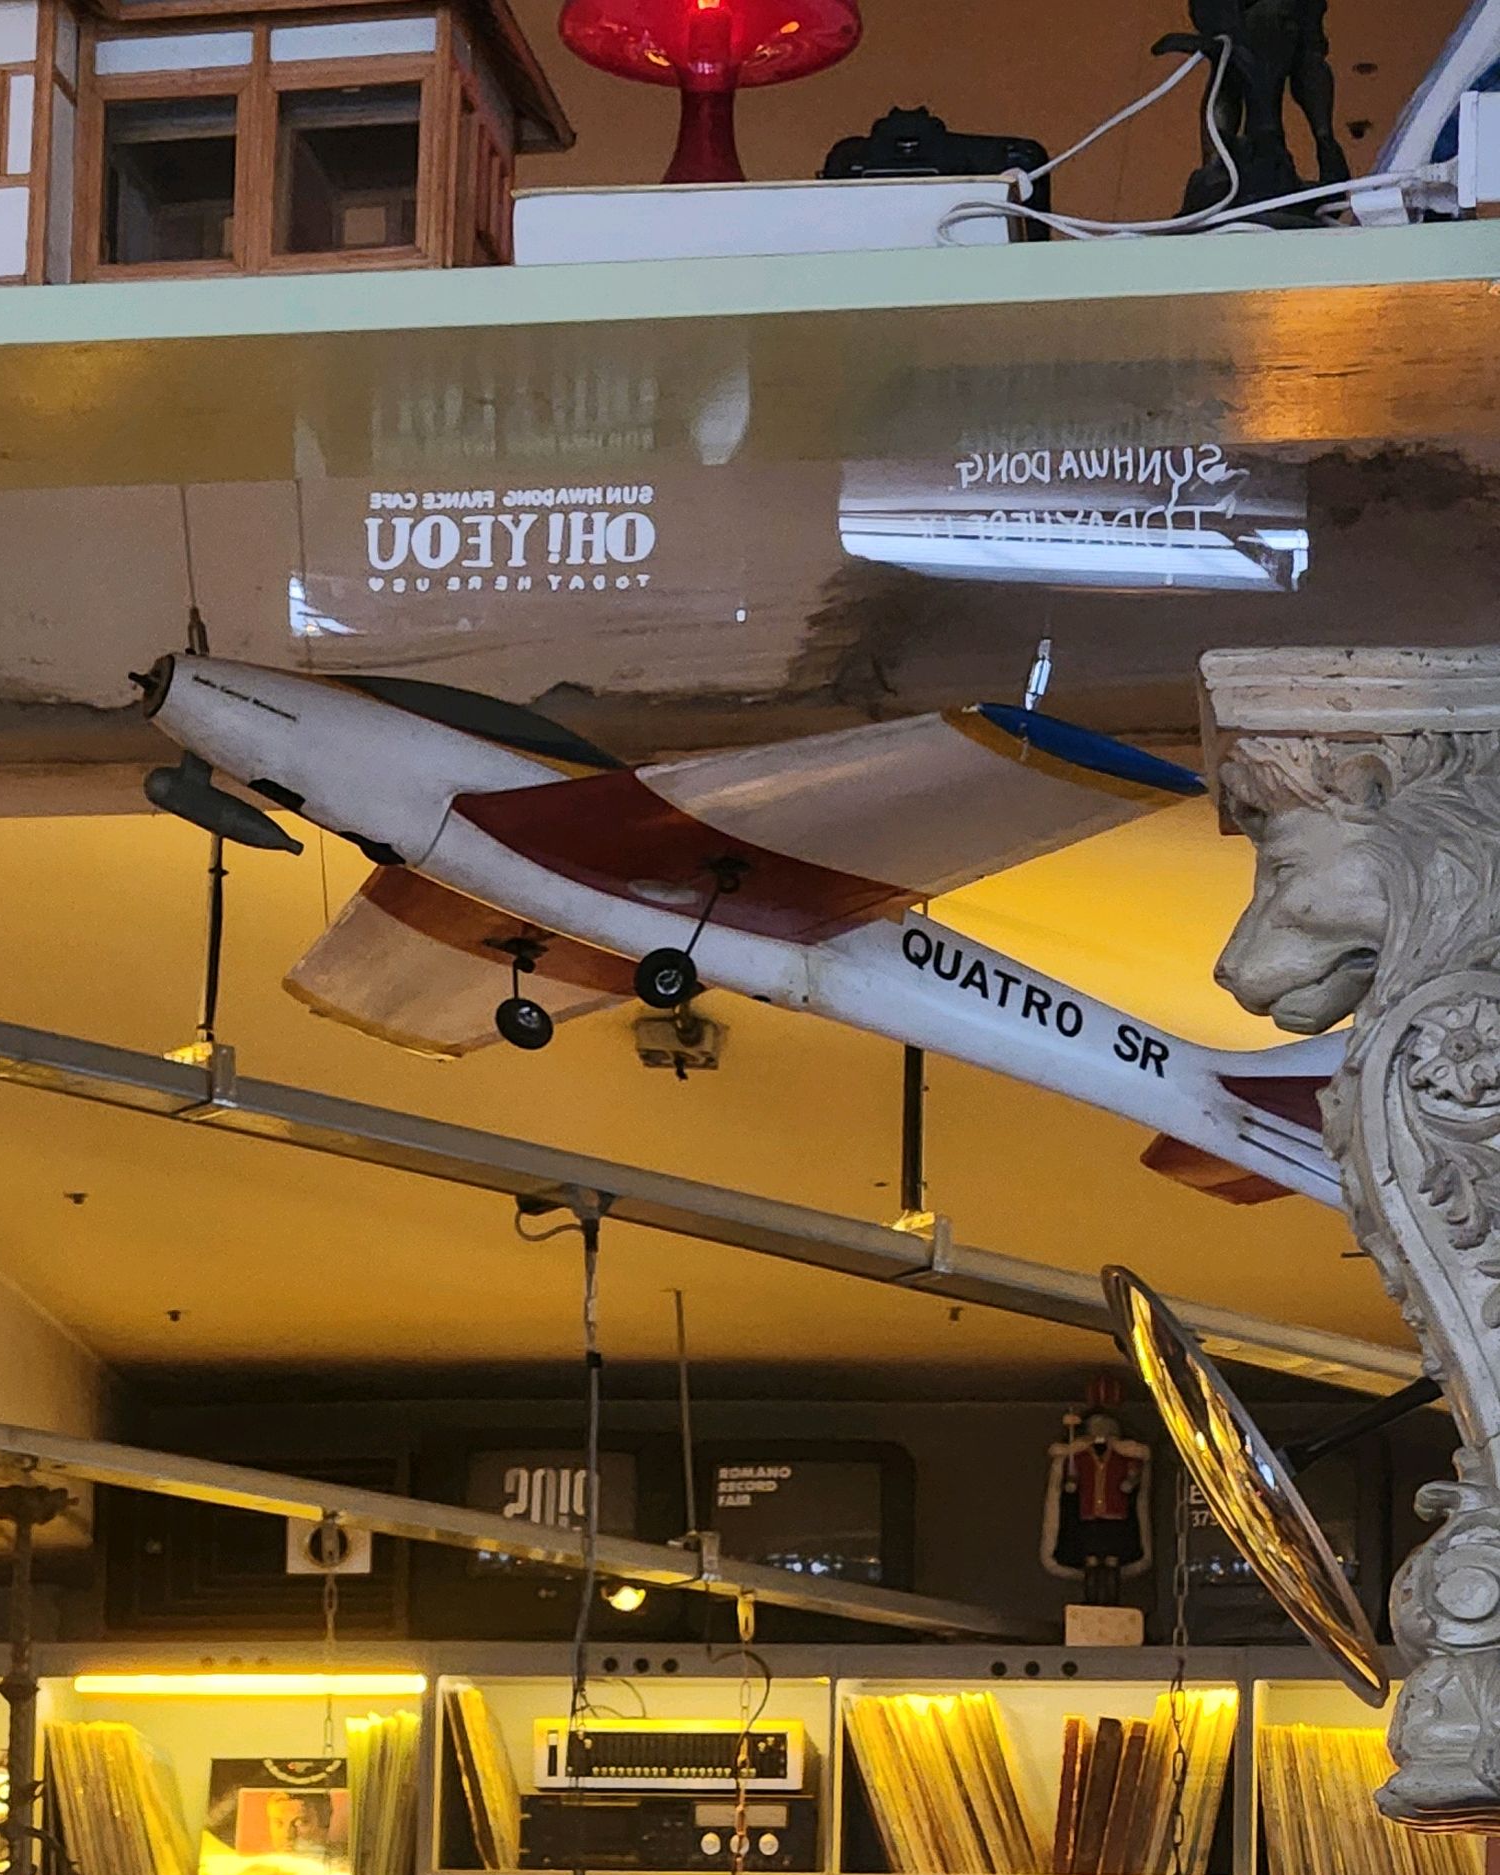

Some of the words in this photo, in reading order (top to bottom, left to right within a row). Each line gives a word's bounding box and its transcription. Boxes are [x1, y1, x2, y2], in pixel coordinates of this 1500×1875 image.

[902, 928, 1083, 1038] QUATRO
[1113, 1023, 1170, 1078] SR
[718, 1480, 779, 1493] RECORD
[717, 1493, 753, 1507] FAIR
